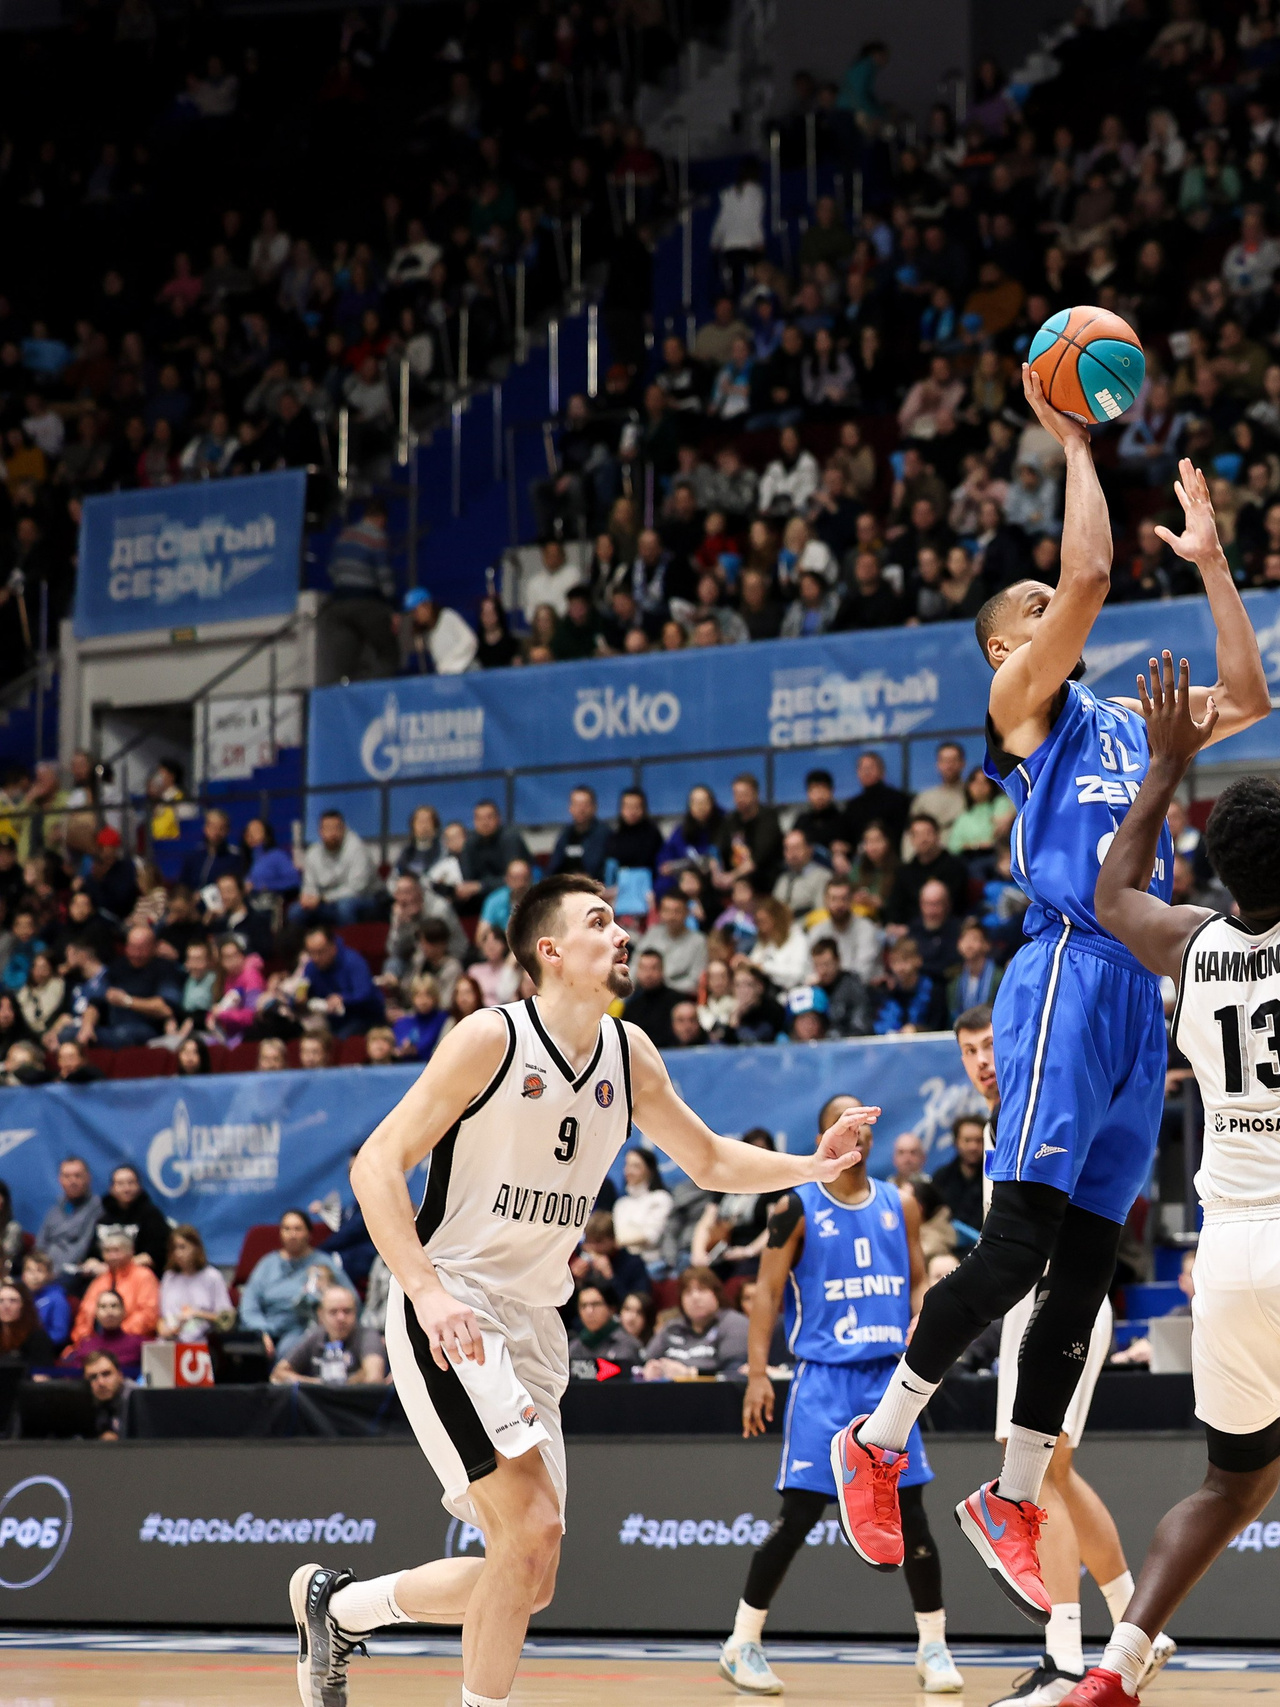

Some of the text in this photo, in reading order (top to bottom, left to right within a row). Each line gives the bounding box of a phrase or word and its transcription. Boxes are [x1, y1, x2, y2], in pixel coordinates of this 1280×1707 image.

[1099, 731, 1144, 774] 32
[1075, 774, 1145, 807] ZEN
[553, 1116, 581, 1166] 9
[490, 1182, 597, 1229] AVTODO
[853, 1237, 872, 1269] 0
[823, 1274, 906, 1302] ZENIT
[139, 1512, 377, 1547] #здесьбаскетбол
